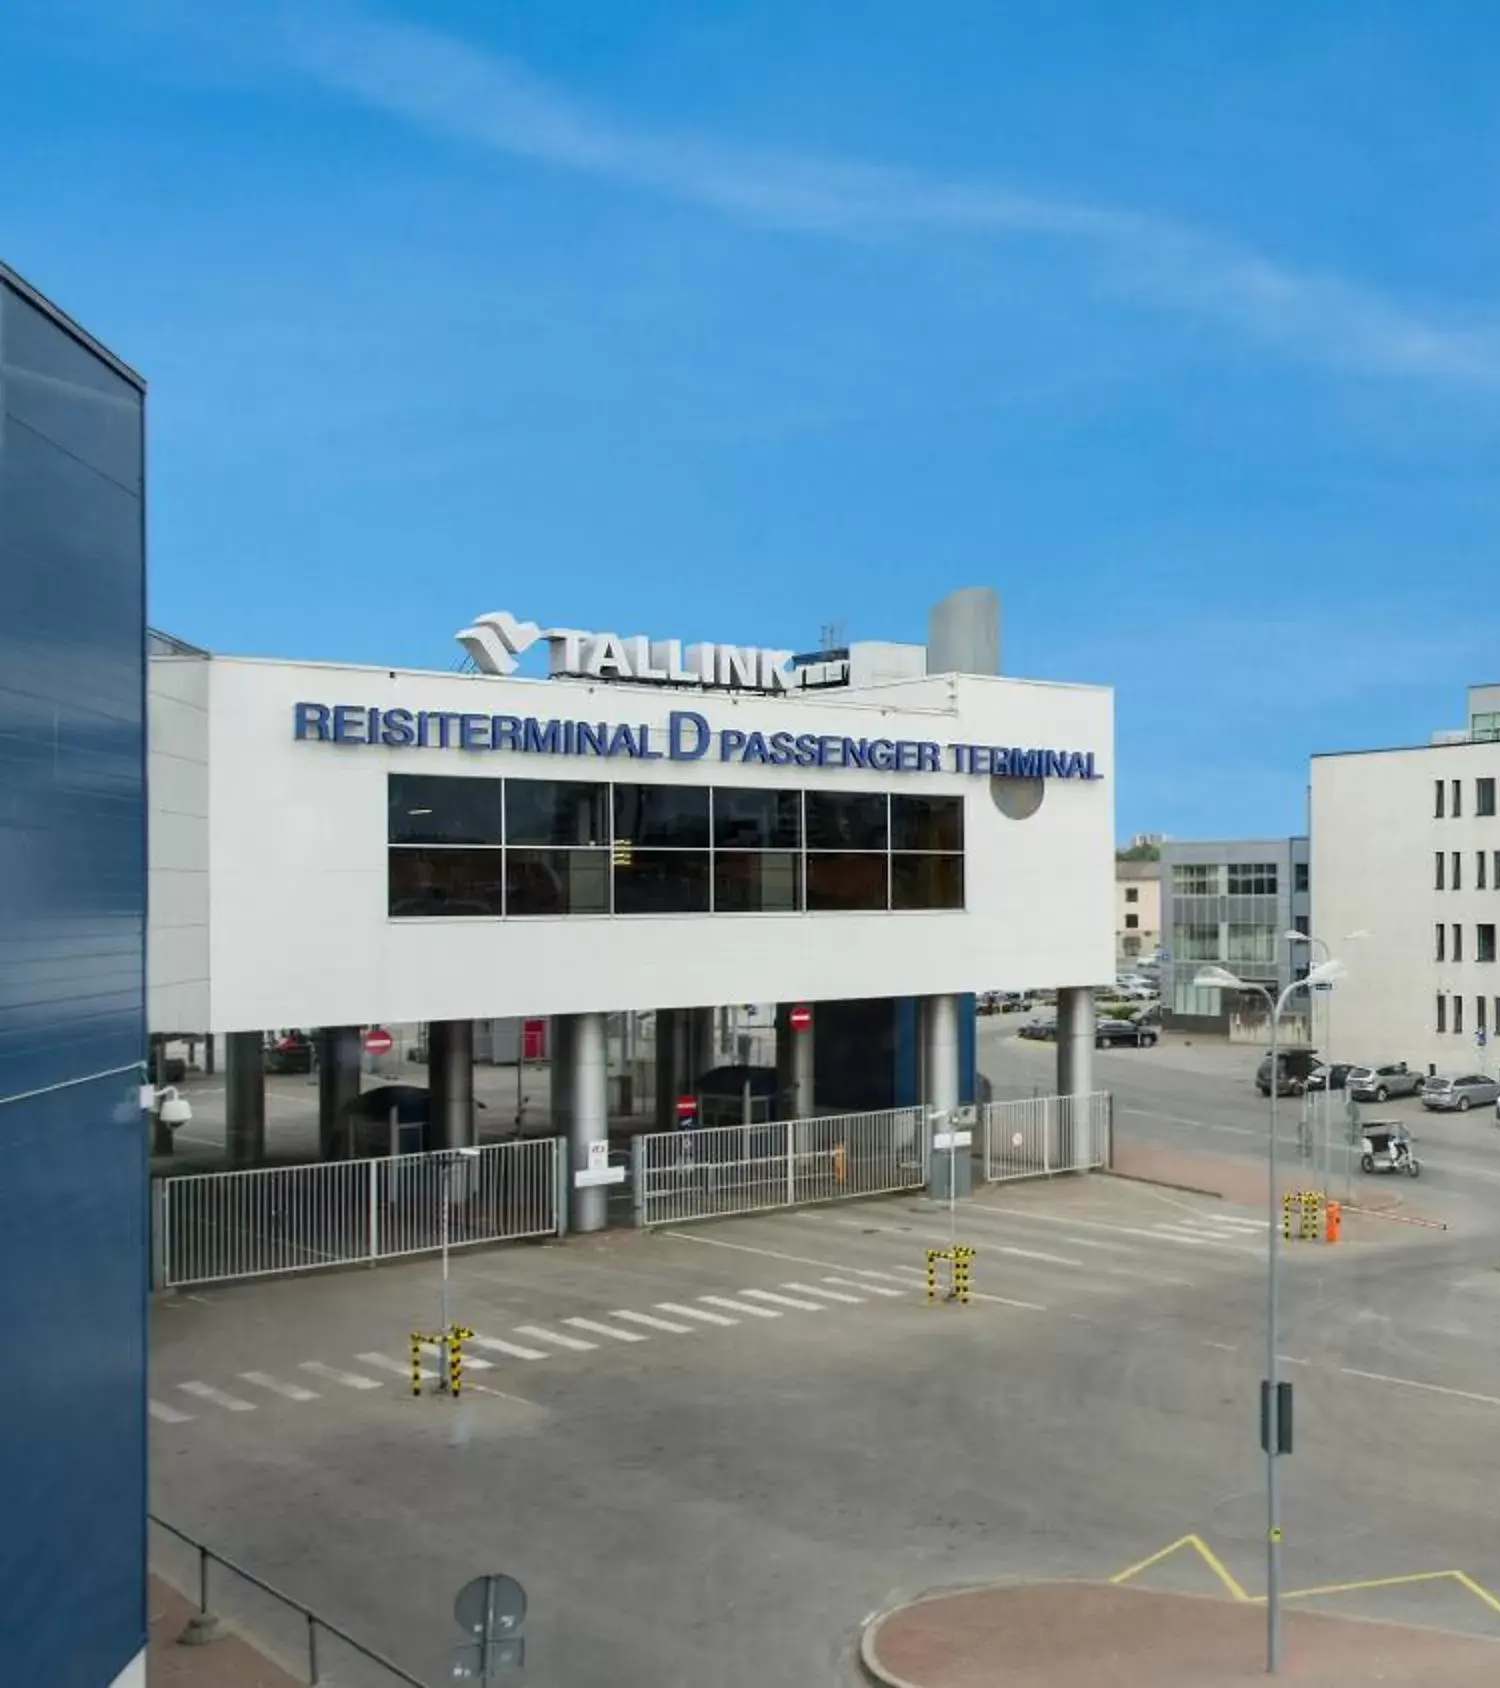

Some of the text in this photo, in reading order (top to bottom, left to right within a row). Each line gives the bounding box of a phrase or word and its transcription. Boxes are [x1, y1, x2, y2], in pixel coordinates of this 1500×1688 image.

[545, 628, 801, 691] TALLINK
[294, 702, 1104, 780] REISITERMINAL D PASSENGER TERMINAL
